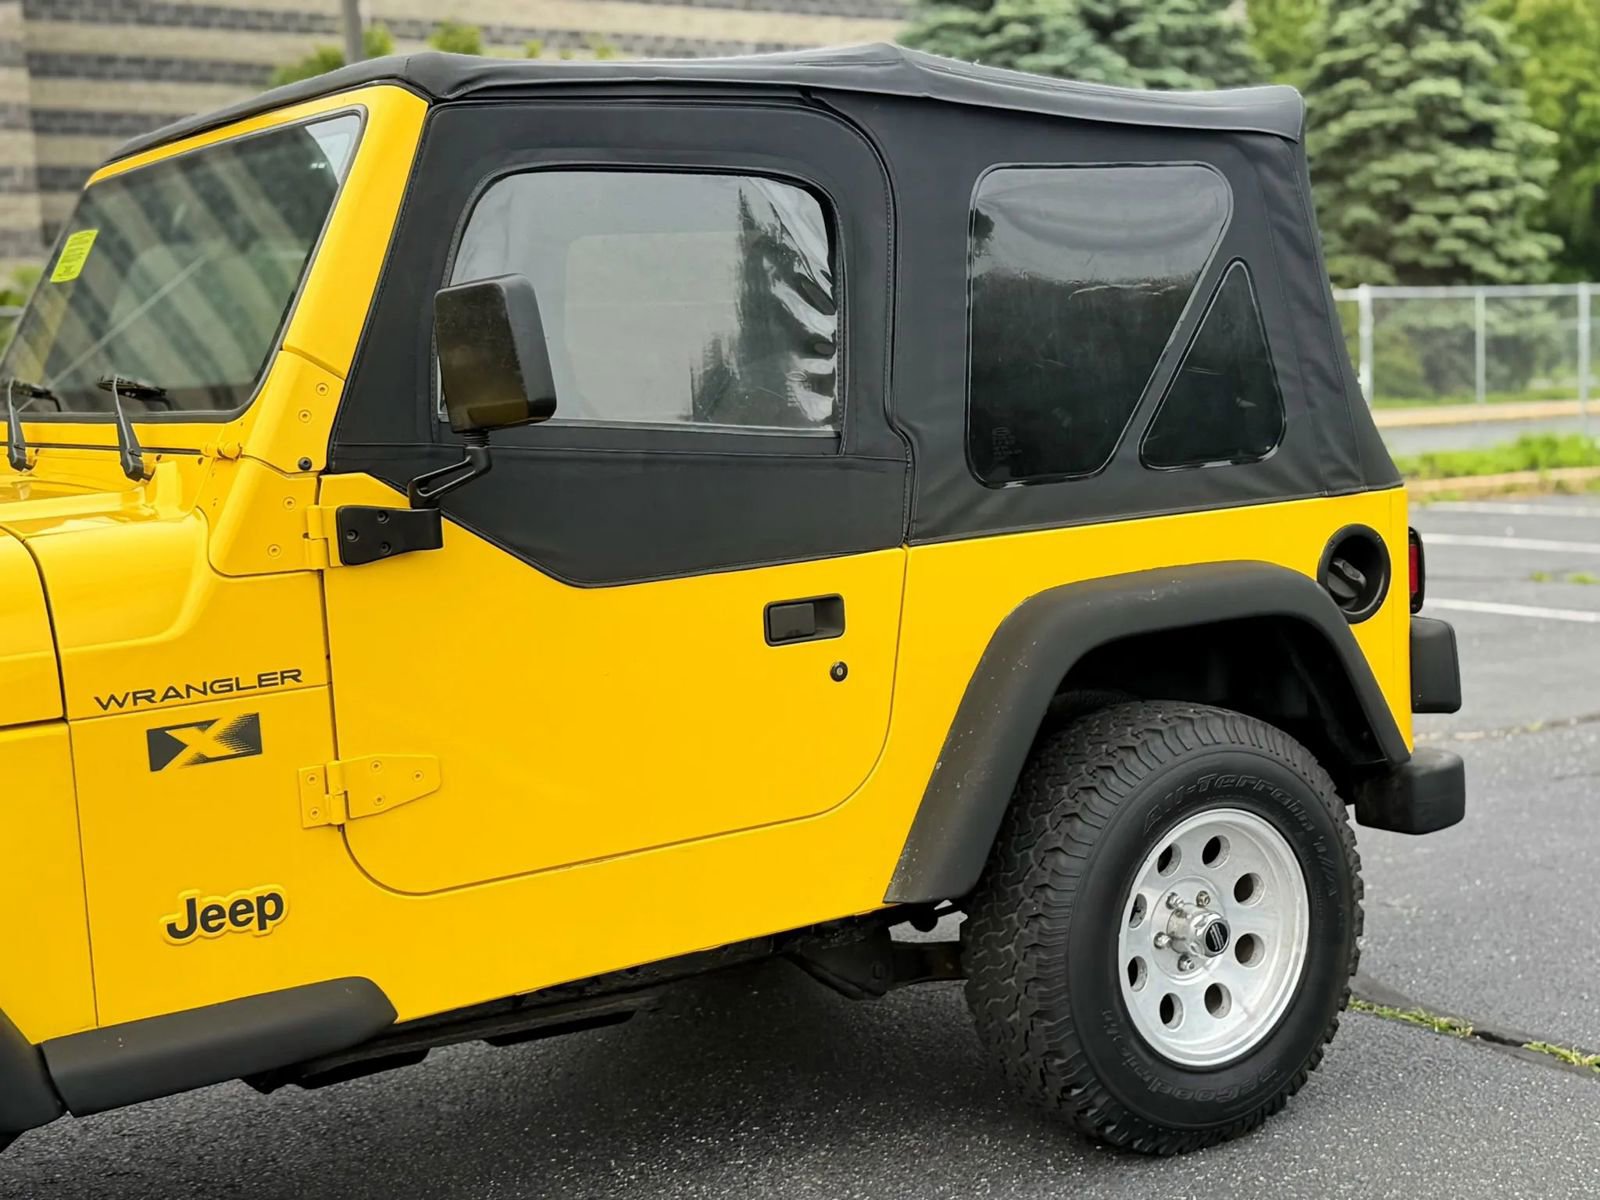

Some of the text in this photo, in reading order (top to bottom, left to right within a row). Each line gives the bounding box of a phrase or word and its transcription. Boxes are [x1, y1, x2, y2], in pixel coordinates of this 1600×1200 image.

[94, 668, 303, 711] WRANGLER
[155, 713, 260, 771] X
[166, 892, 284, 939] Jeep
